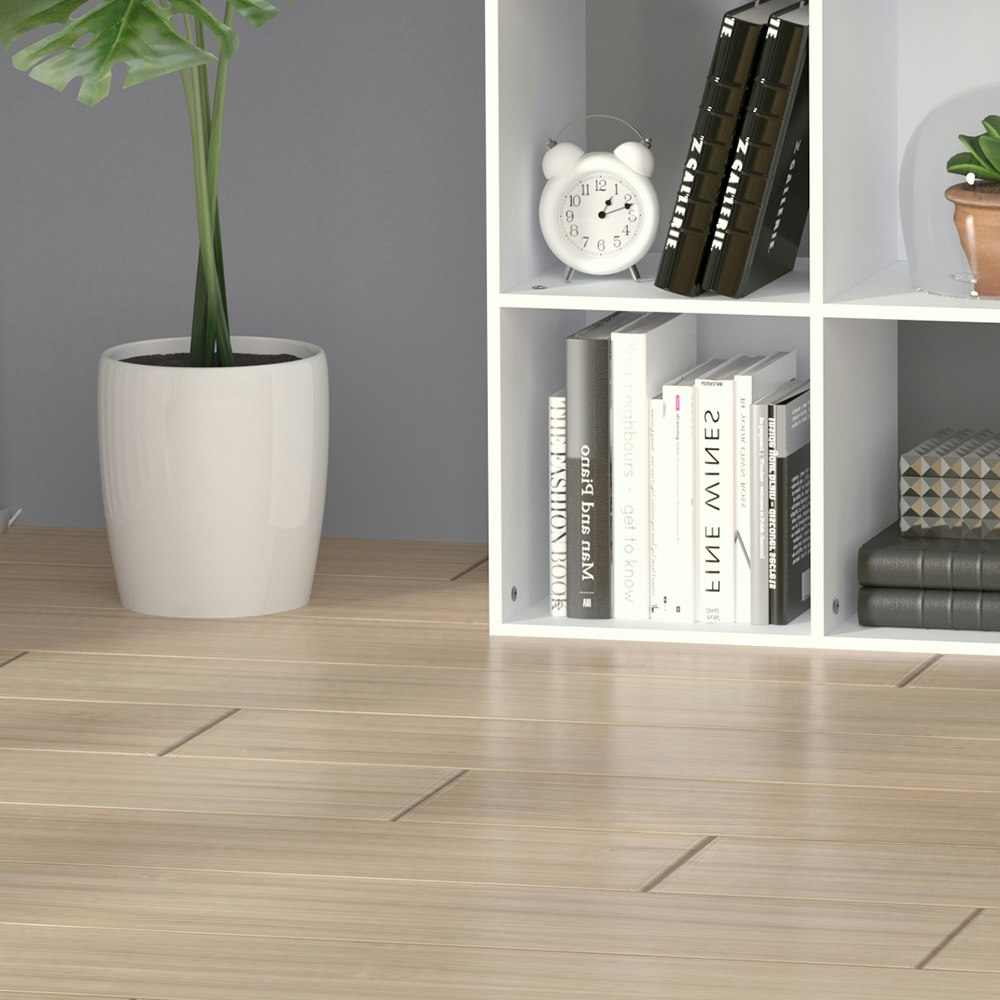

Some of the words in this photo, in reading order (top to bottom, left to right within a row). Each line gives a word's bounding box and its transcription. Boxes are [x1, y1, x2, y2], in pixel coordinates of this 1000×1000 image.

[581, 183, 590, 196] 11
[595, 179, 607, 192] 12
[614, 183, 619, 195] 1
[569, 195, 582, 208] 10
[565, 210, 575, 223] 9
[569, 224, 579, 237] 8
[621, 224, 631, 236] 4
[582, 236, 590, 249] 7
[597, 238, 606, 252] 6
[613, 235, 622, 248] 5
[550, 400, 567, 446] THE
[550, 452, 567, 543] FASHION
[620, 504, 637, 531] get
[624, 538, 637, 554] to
[550, 551, 567, 611] BOOK
[624, 560, 638, 604] know
